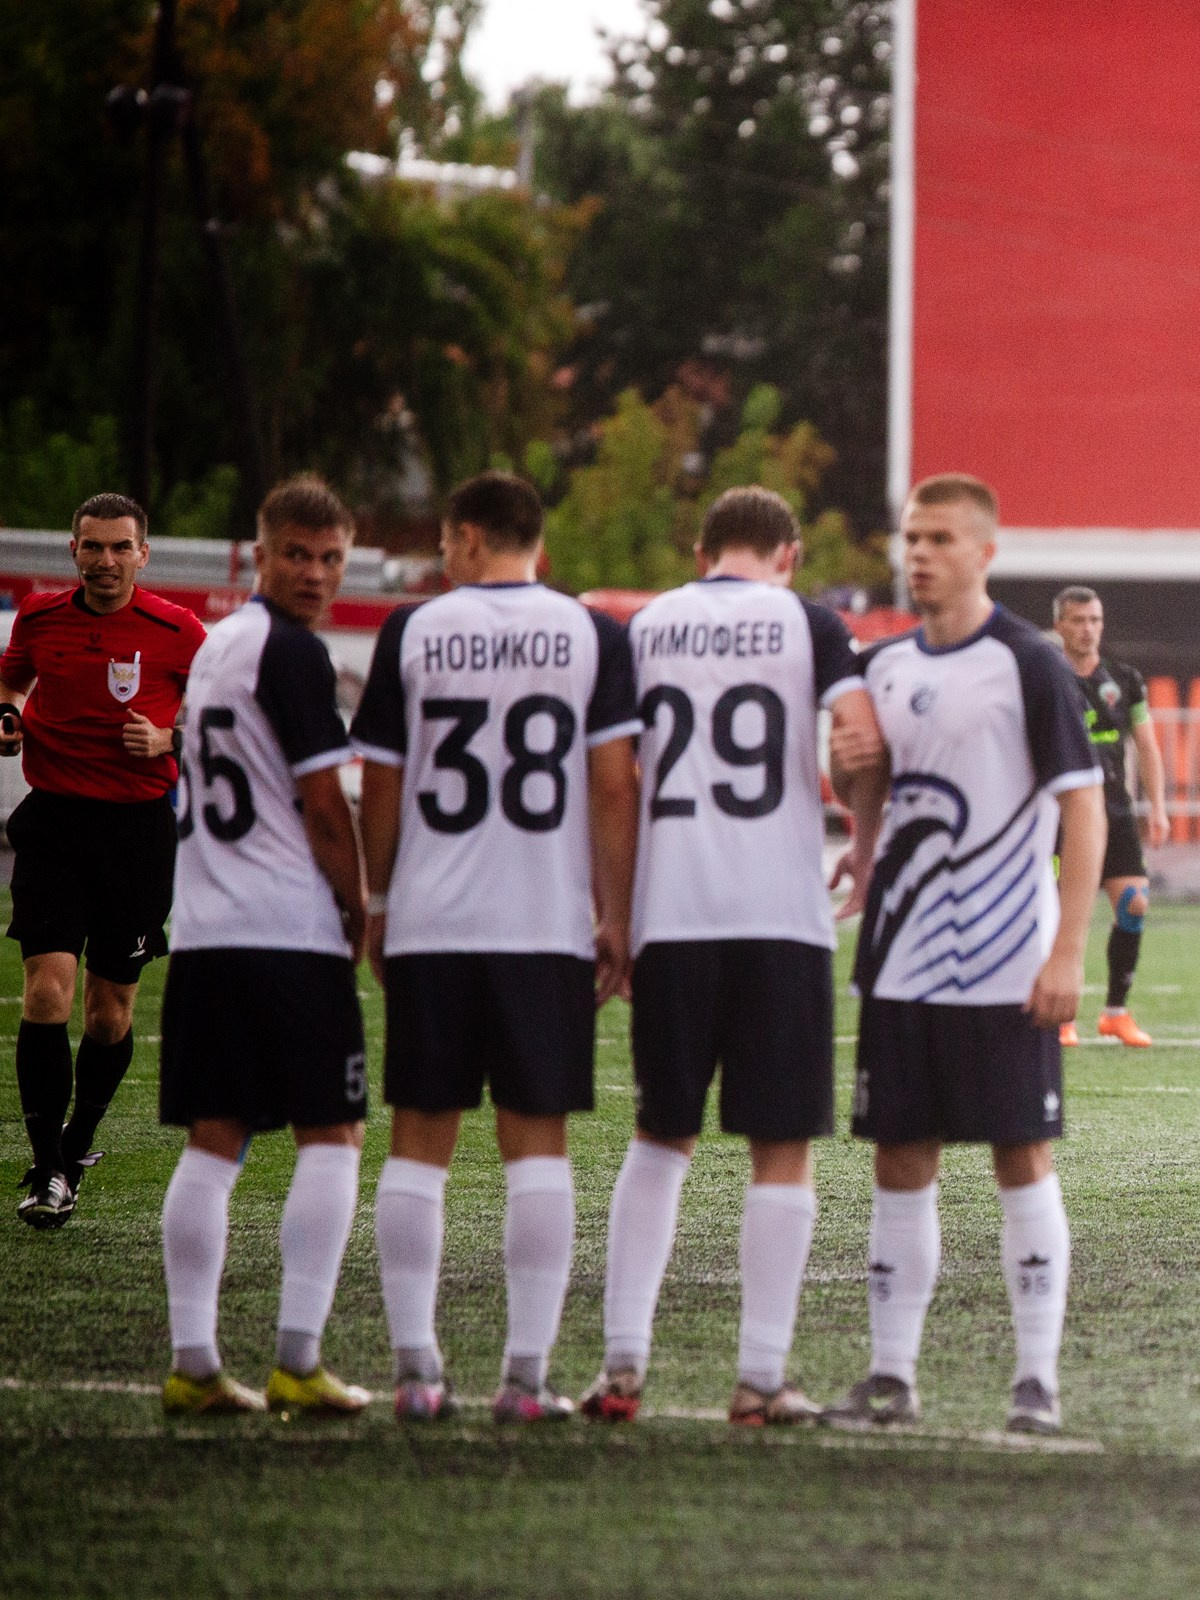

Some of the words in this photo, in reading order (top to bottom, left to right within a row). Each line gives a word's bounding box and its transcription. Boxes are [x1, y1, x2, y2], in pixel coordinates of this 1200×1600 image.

[424, 630, 571, 672] НОВИКОВ
[417, 694, 577, 834] 38
[641, 683, 787, 819] 29
